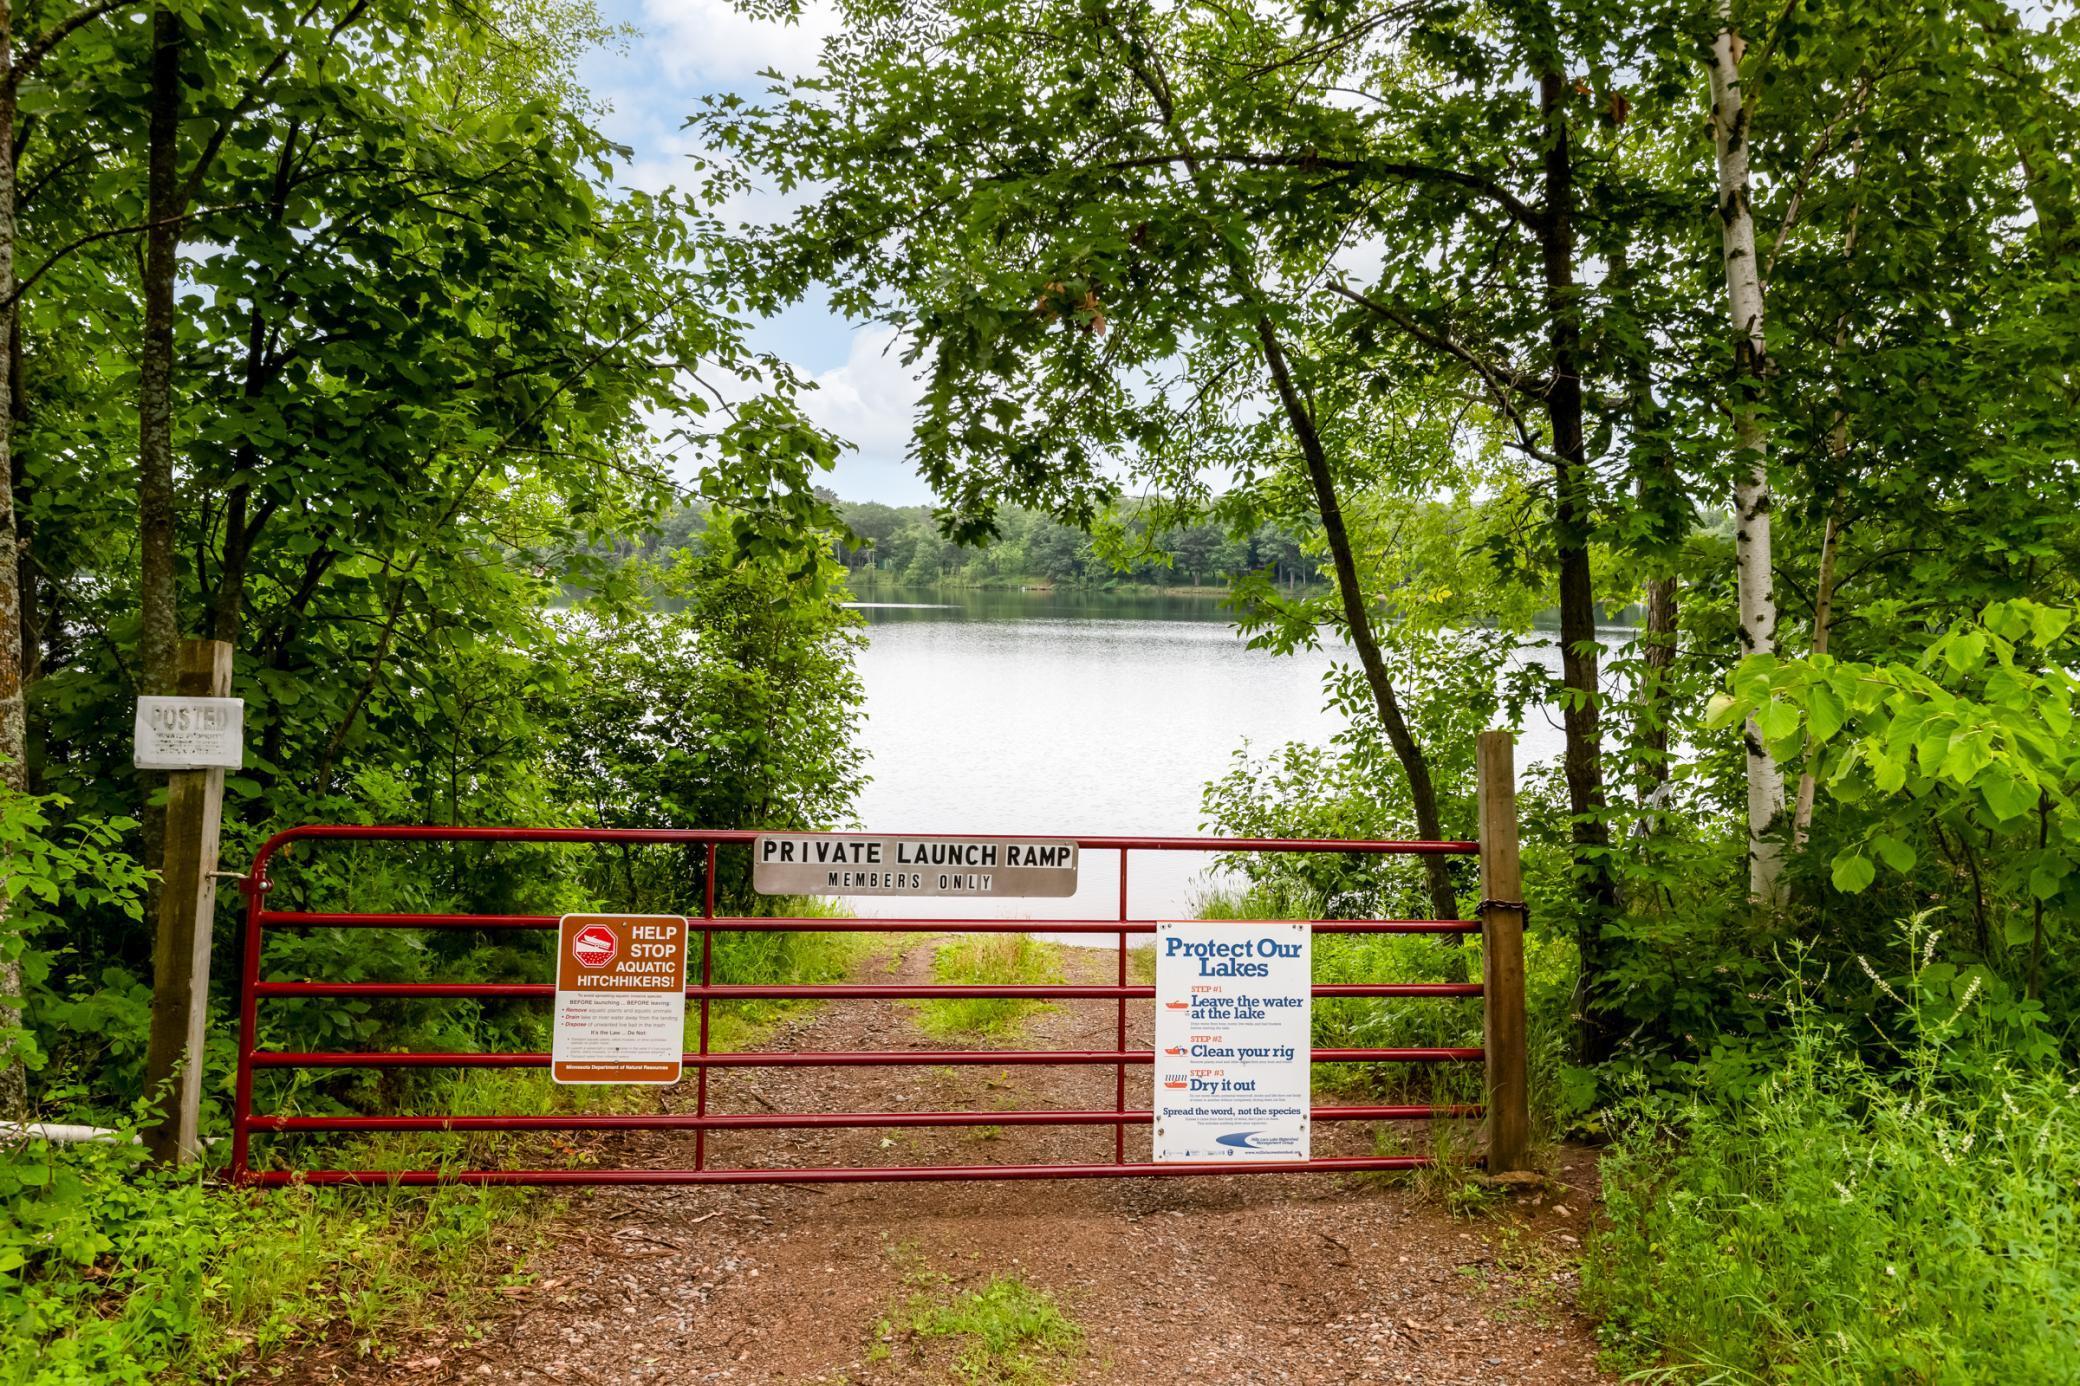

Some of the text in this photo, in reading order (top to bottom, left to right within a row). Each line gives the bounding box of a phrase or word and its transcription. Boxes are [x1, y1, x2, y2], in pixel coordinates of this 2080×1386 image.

[763, 840, 1071, 868] PRIVATE LAUNCH RAMP
[828, 872, 991, 891] MEMBERS ONLY
[632, 926, 677, 940] HELP
[630, 944, 676, 958] STOP
[1165, 937, 1302, 958] Protect Our
[616, 961, 676, 973] AQUATIC
[1198, 957, 1269, 977] Lakes
[577, 975, 674, 987] HITCHHIKERS!
[1191, 985, 1222, 993] STEP #1
[1191, 995, 1304, 1008] Leave the water
[1191, 1007, 1265, 1020] at the lake
[1190, 1035, 1222, 1043] STEP #2
[1191, 1044, 1295, 1061] Clean your rig
[1190, 1069, 1225, 1077] STEP #3
[1190, 1078, 1256, 1094] Dry it out
[1163, 1107, 1194, 1117] Spread
[1195, 1107, 1209, 1115] the
[1211, 1107, 1236, 1116] word,
[1253, 1107, 1267, 1115] the
[1268, 1107, 1301, 1117] species
